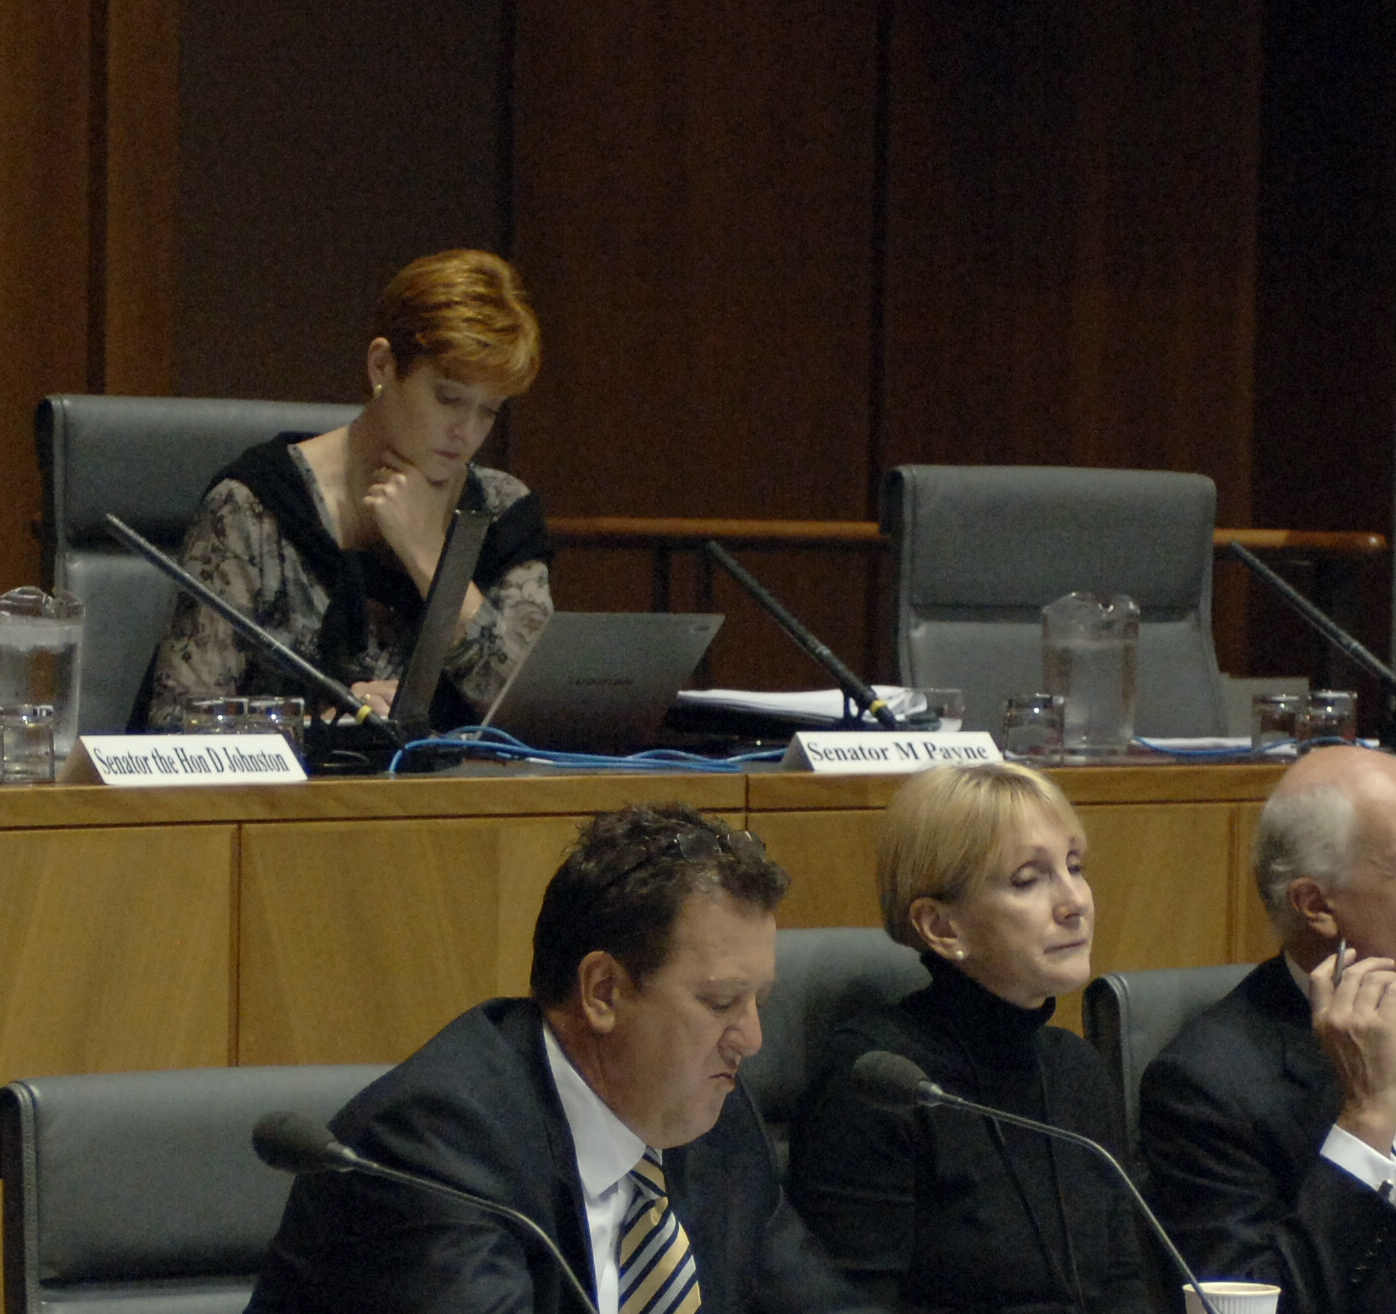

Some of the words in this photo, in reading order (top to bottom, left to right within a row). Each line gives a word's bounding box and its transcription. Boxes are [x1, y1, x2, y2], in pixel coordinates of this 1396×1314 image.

[93, 747, 154, 775] Senator
[154, 748, 179, 774] the
[174, 747, 211, 774] Hon
[205, 747, 225, 773] D
[222, 747, 290, 773] Johnston
[807, 742, 889, 762] Senator
[893, 741, 919, 761] M
[923, 742, 989, 765] Payne
